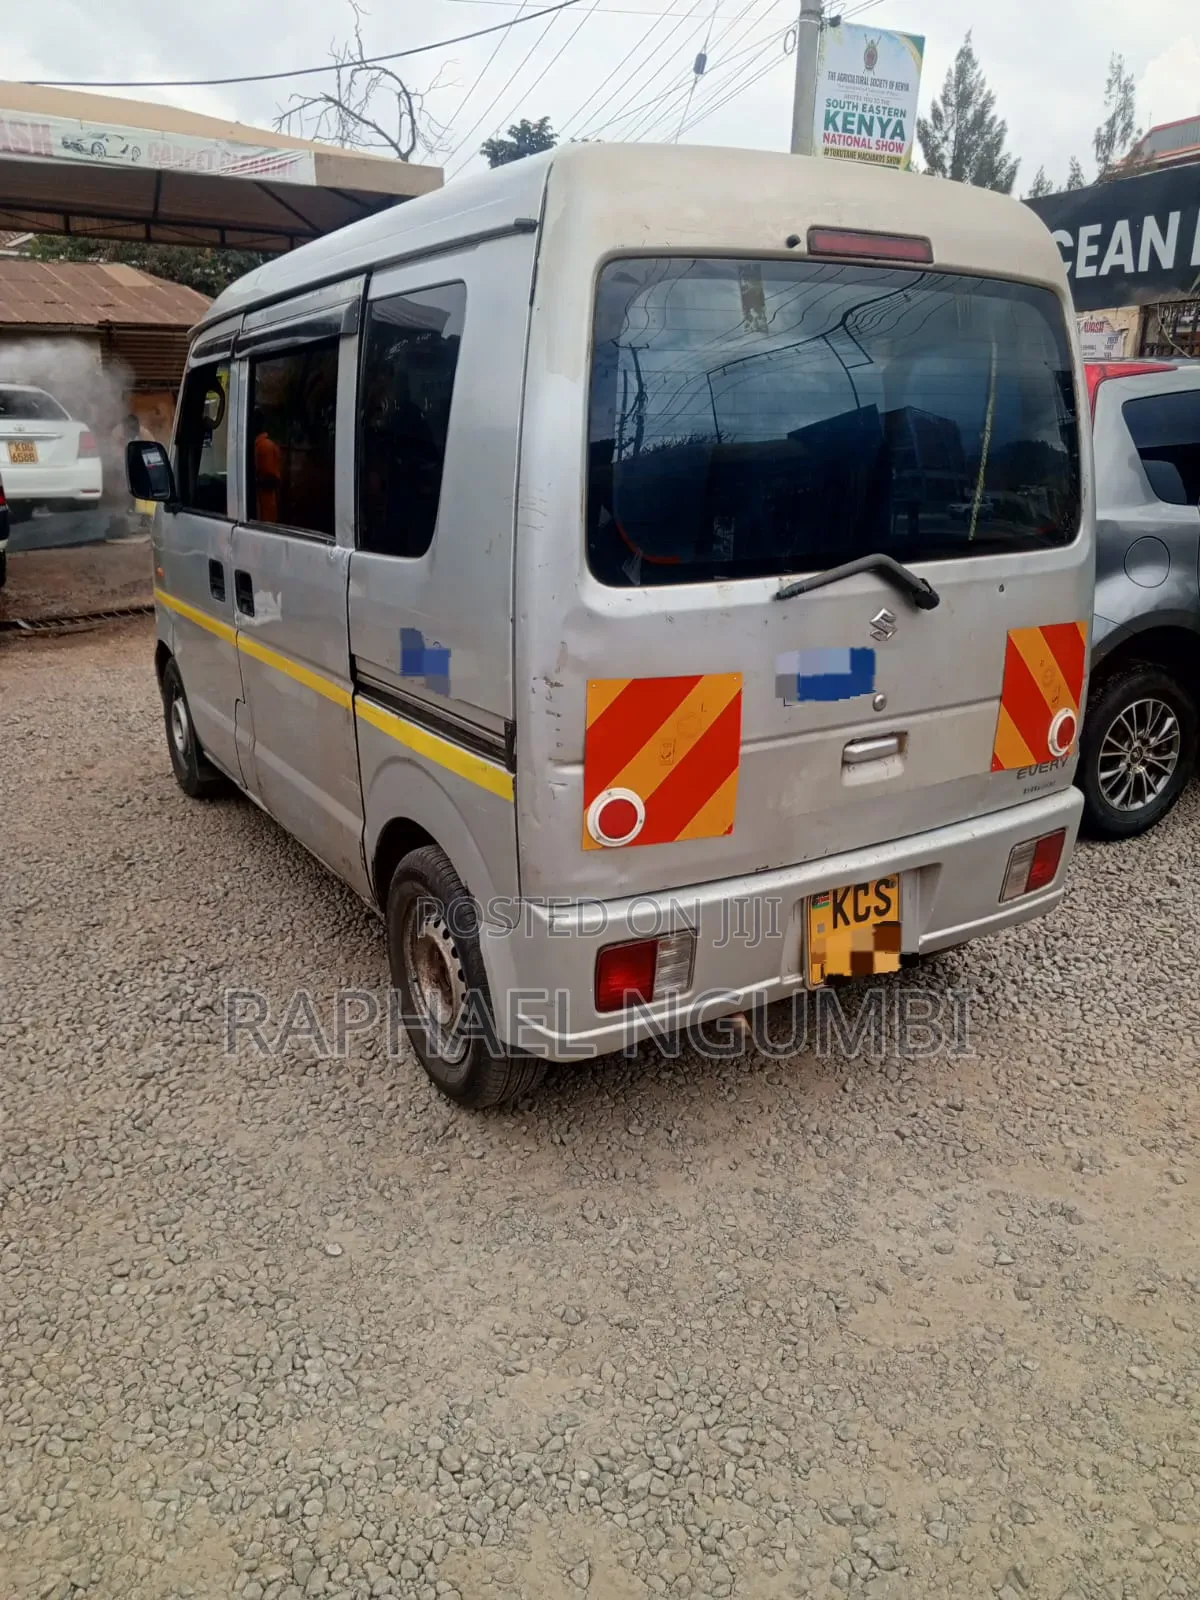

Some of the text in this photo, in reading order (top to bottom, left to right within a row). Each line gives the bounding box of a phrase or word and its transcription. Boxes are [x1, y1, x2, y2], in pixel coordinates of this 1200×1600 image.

[828, 71, 836, 80] THE
[837, 73, 869, 86] AGRICULTURAL
[870, 77, 888, 89] SOCIETY
[889, 80, 894, 89] OF
[895, 81, 909, 92] KENYA
[825, 98, 907, 118] SOUTH EASTERN
[824, 109, 906, 141] KENYA
[823, 132, 904, 154] NATIONAL SHOW
[887, 155, 901, 165] SHOW
[1016, 756, 1069, 779] EVERY
[832, 878, 893, 929] KCS
